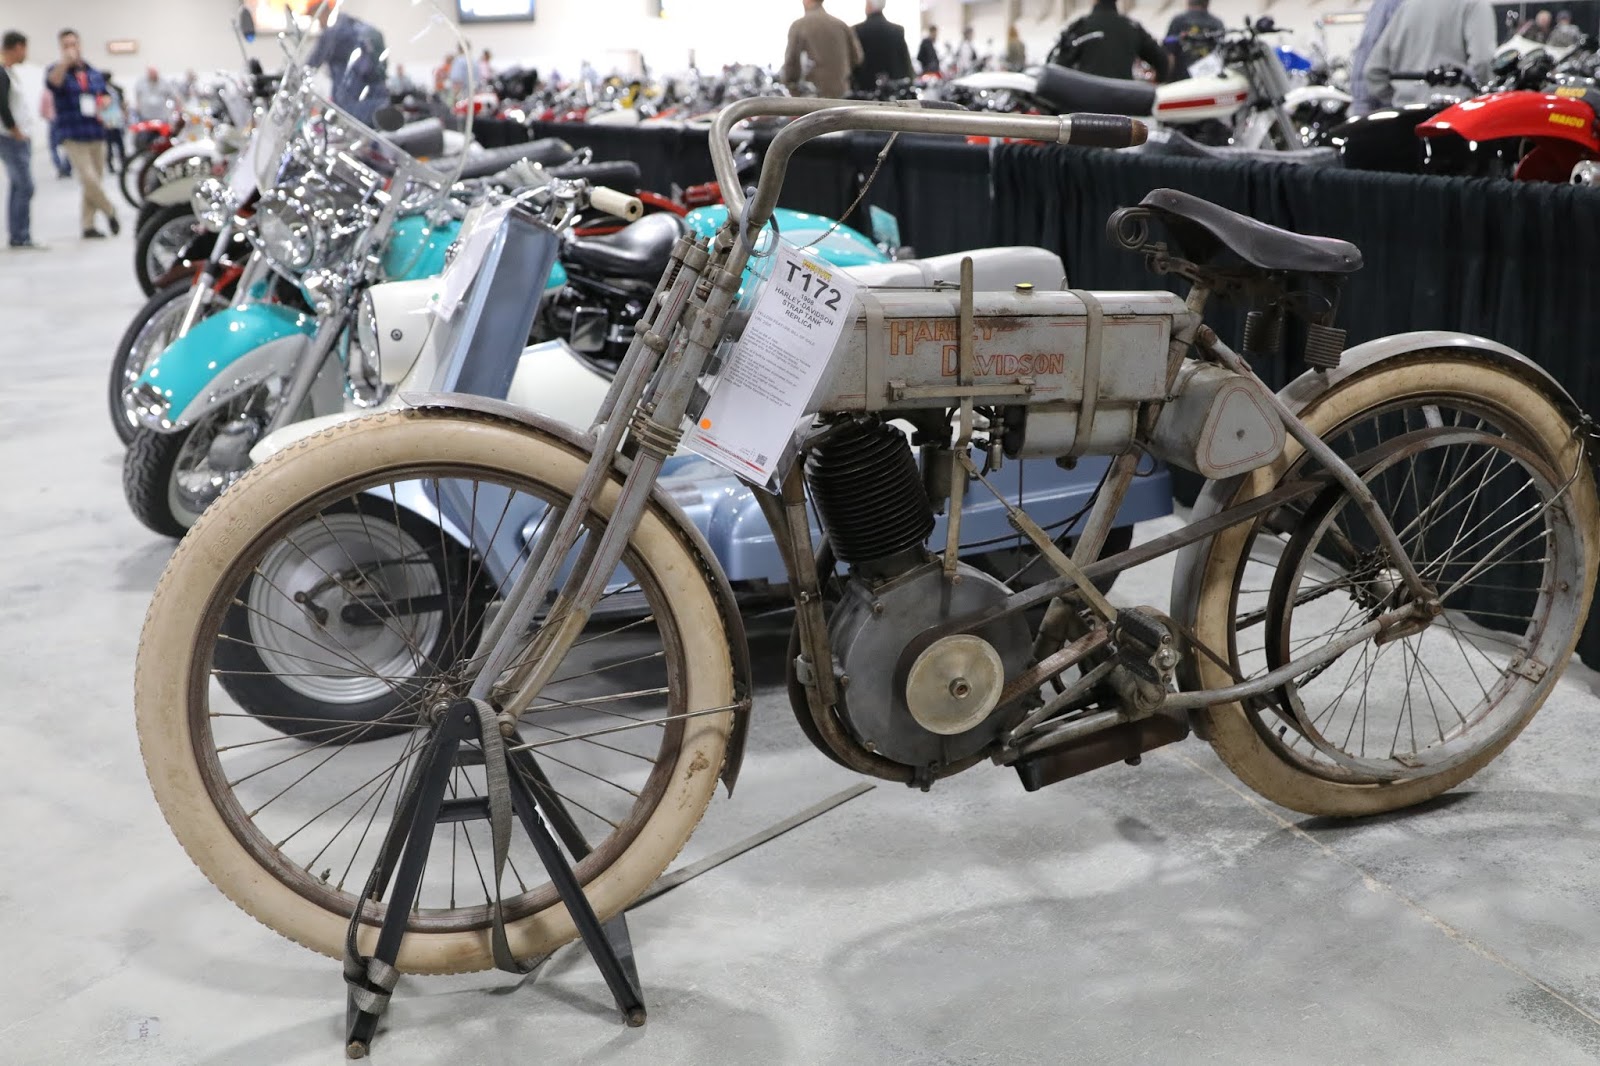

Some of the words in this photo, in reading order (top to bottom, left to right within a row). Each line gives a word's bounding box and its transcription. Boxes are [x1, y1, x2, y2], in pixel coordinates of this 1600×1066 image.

[1549, 113, 1586, 128] MAICO
[786, 260, 842, 312] T172
[774, 287, 835, 327] HARLEY-DAVIDSON
[781, 299, 804, 315] STRAP
[804, 312, 822, 327] TANK
[784, 309, 813, 330] REPLICA
[890, 320, 995, 355] HARLY
